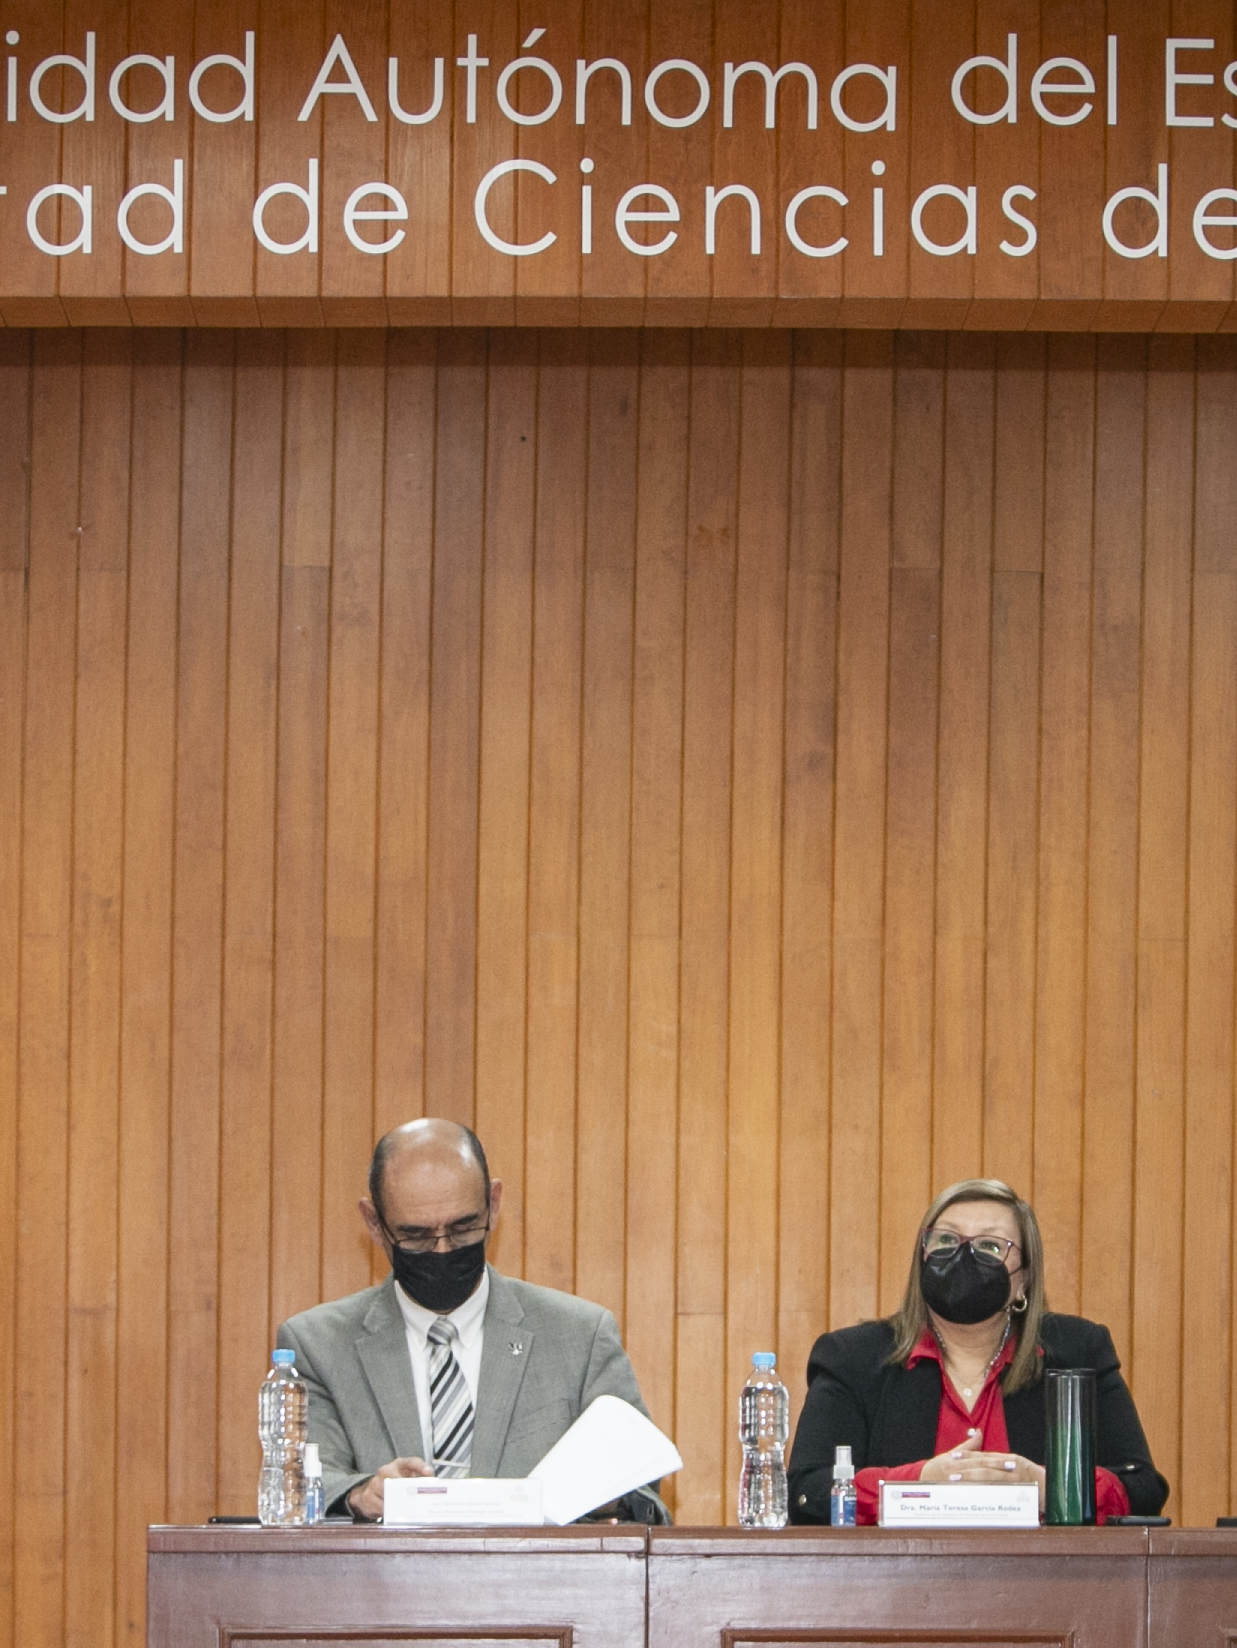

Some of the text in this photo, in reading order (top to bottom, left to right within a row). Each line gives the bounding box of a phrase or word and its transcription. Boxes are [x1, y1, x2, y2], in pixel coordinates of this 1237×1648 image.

[296, 28, 897, 132] Autónoma
[951, 33, 1118, 126] del
[252, 158, 409, 256] de
[474, 157, 1038, 257] Ciencias
[1102, 162, 1237, 260] de
